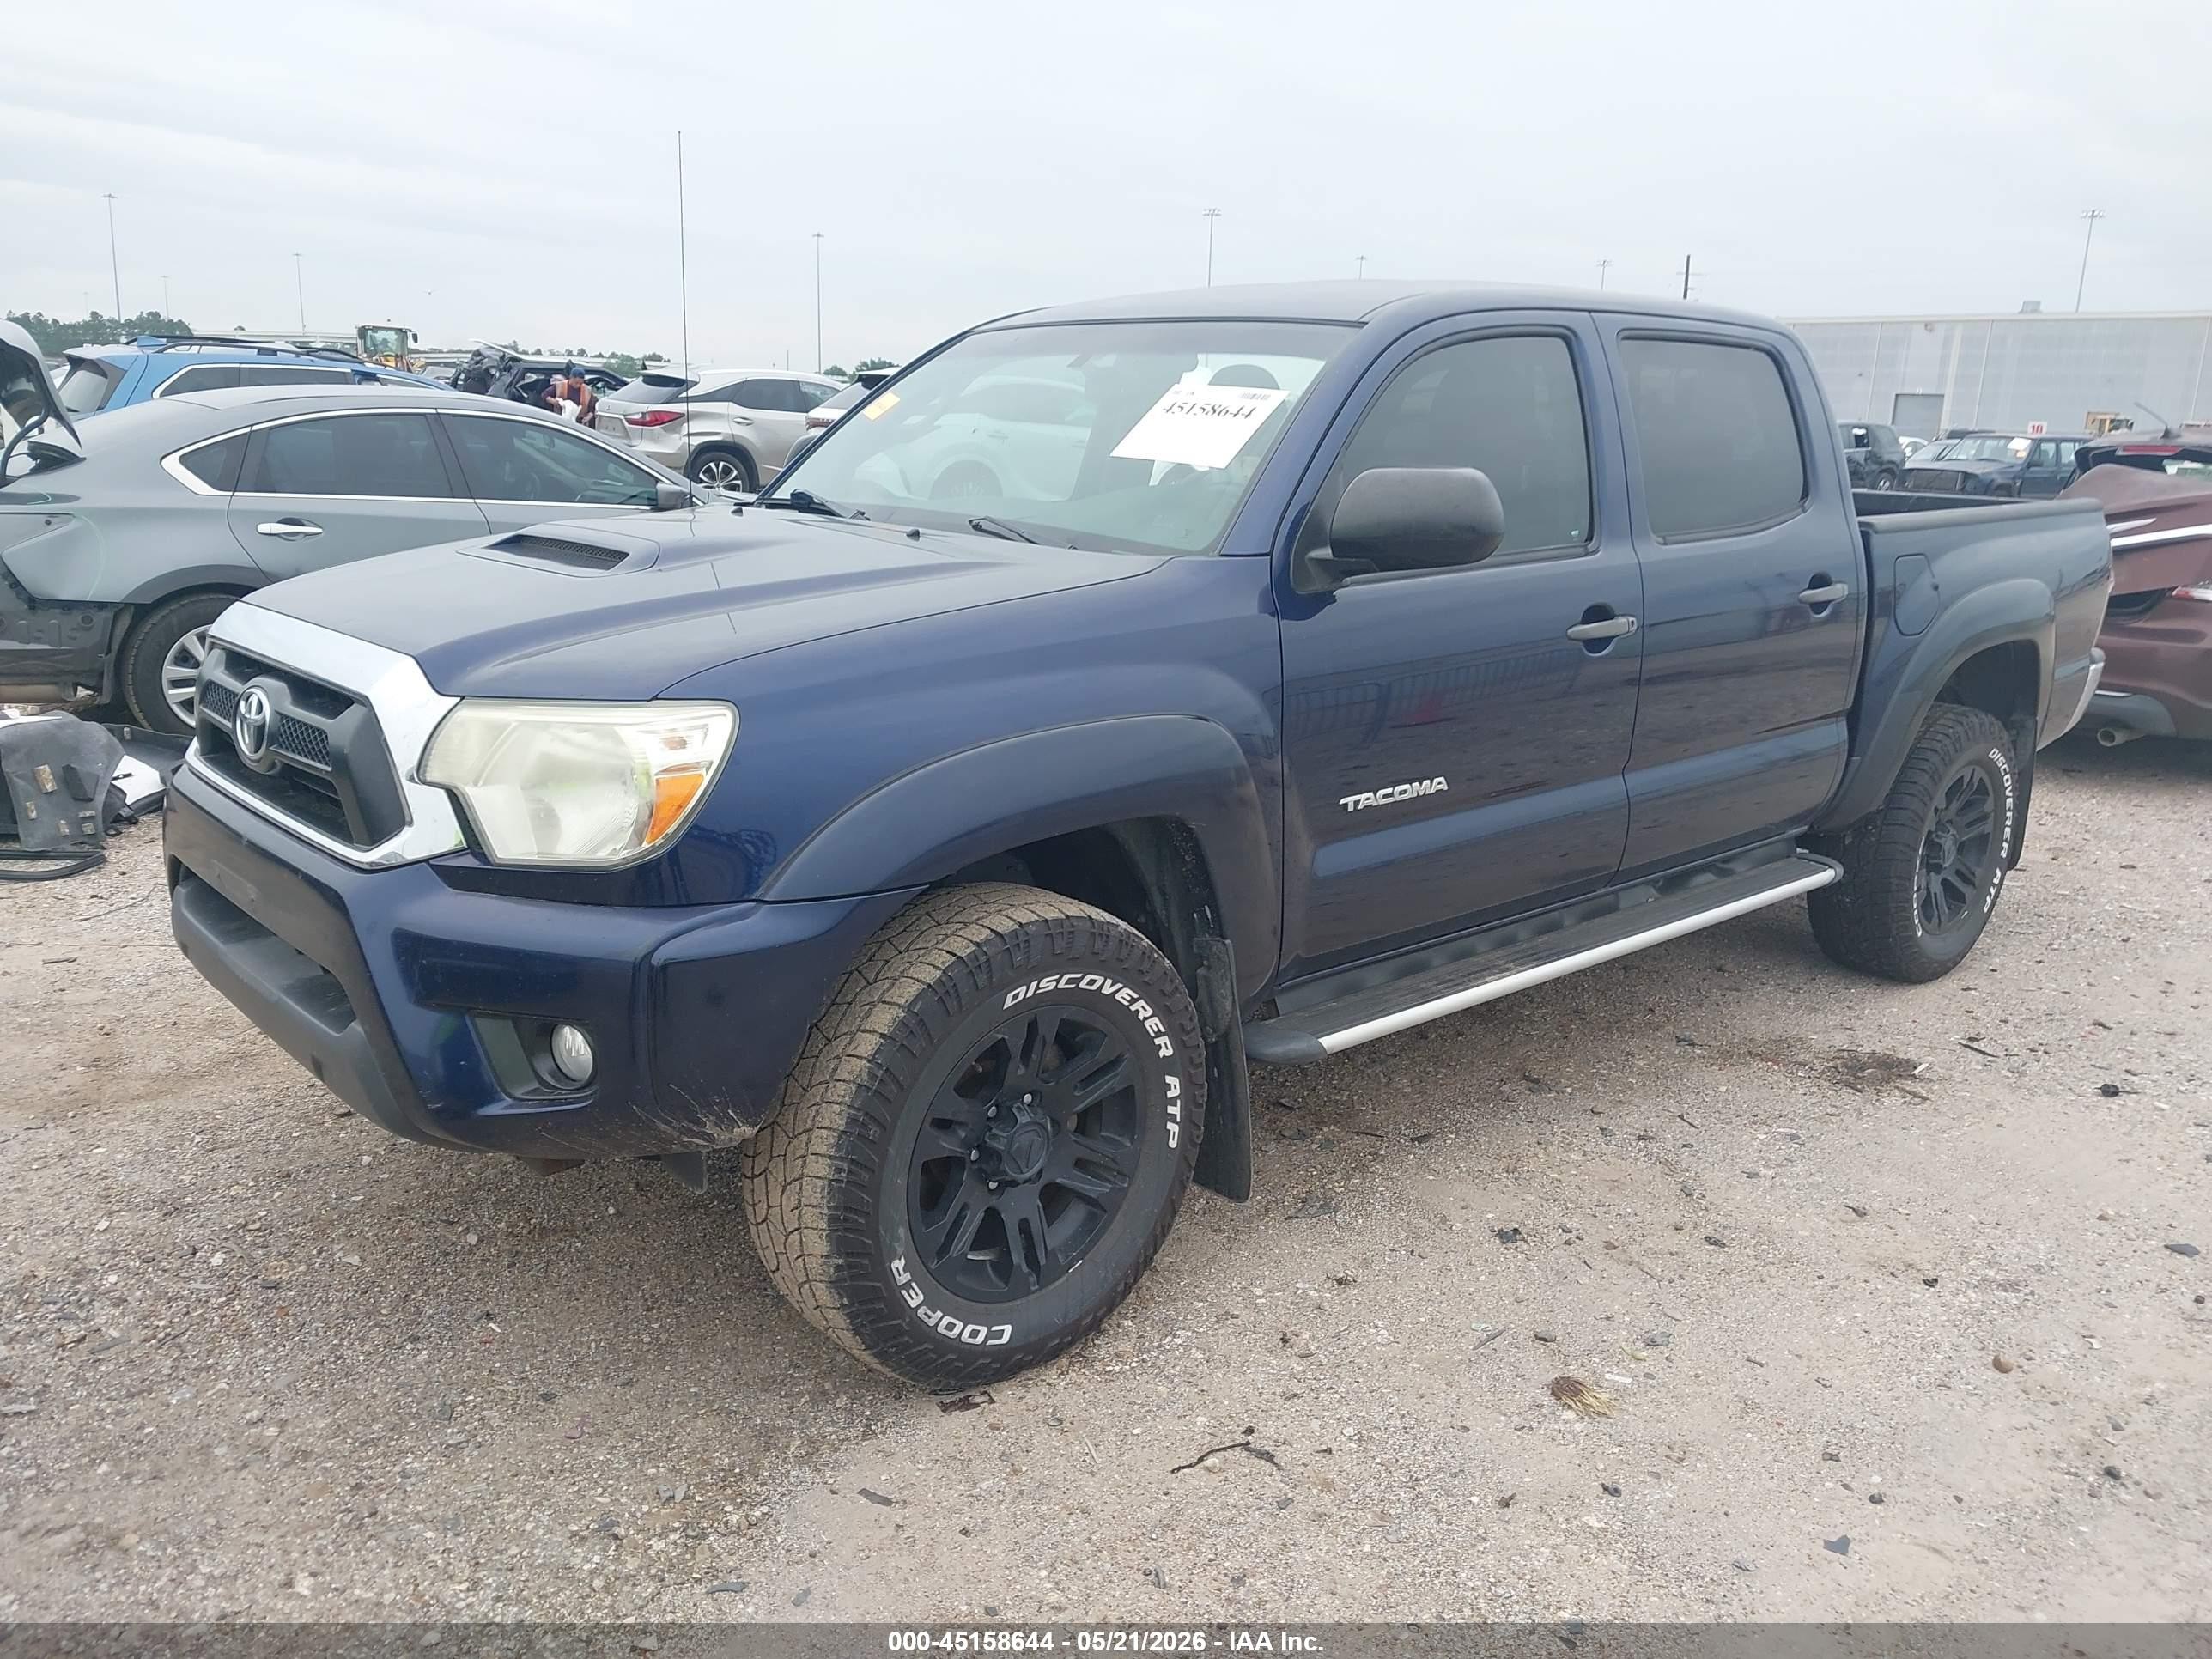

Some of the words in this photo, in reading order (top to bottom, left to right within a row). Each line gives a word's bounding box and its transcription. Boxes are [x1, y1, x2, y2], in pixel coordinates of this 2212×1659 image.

[1163, 401, 1257, 420] 45158644
[1339, 775, 1449, 812] TACOMA
[1988, 747, 2014, 859] DISCOVERER
[1983, 867, 2002, 914] ATP
[1002, 973, 1174, 1059] DISCOVERER
[1164, 1073, 1182, 1149] ATP
[890, 1255, 1013, 1346] COOPER
